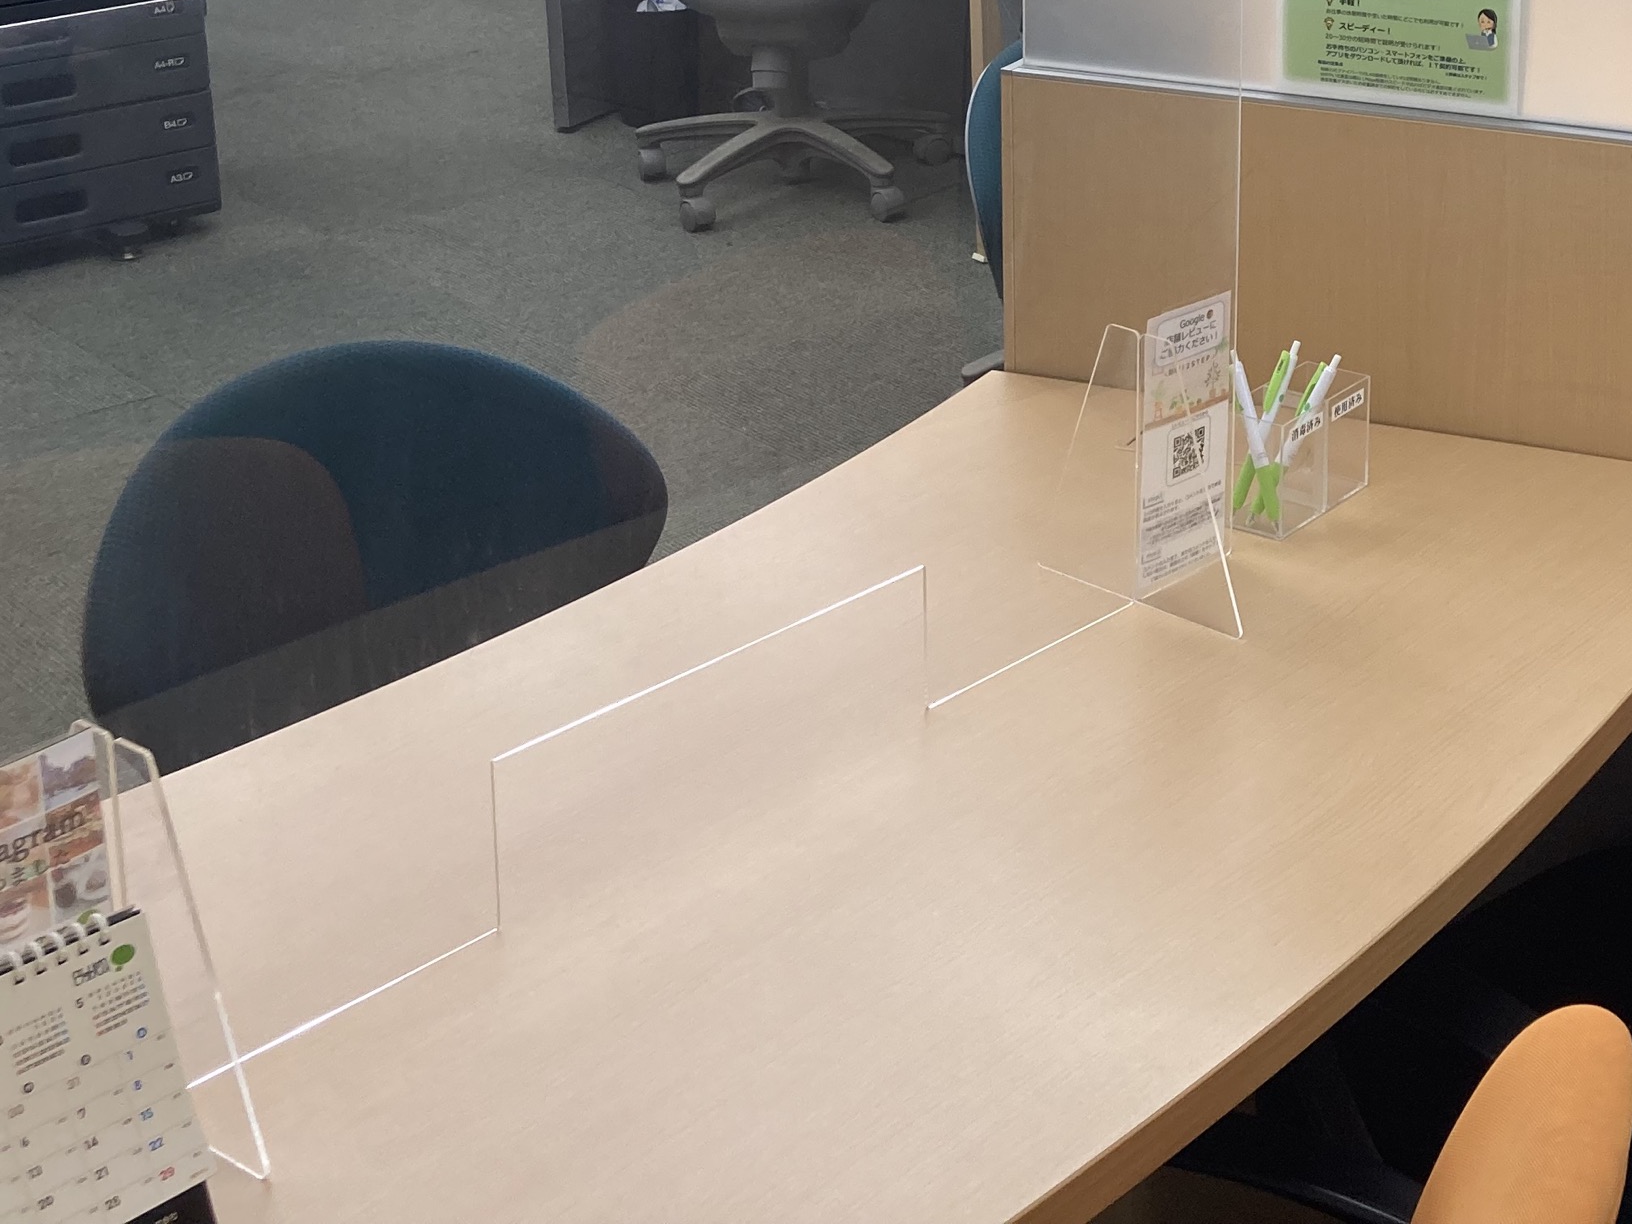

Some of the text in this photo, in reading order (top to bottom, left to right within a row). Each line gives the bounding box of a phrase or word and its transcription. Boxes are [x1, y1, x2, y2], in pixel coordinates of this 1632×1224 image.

[153, 3, 167, 15] A4
[1338, 22, 1392, 36] スピーディー！
[1179, 313, 1206, 329] Google
[1333, 391, 1363, 418] 使用済み
[75, 997, 85, 1009] 5
